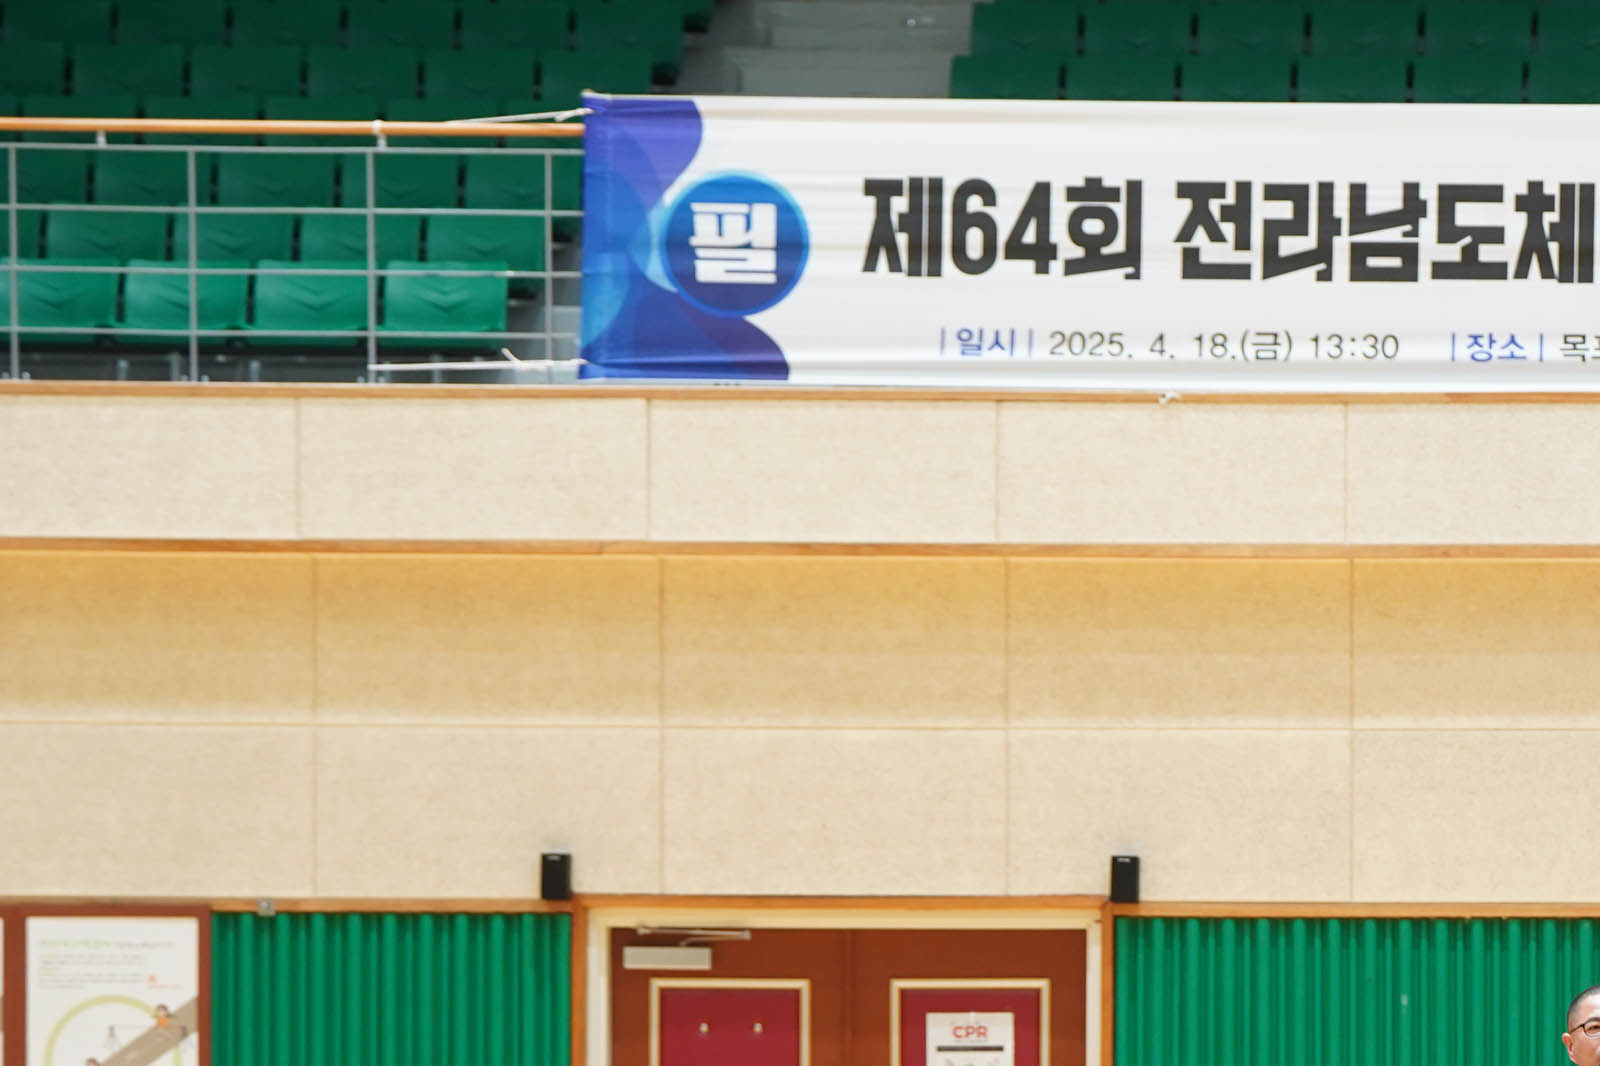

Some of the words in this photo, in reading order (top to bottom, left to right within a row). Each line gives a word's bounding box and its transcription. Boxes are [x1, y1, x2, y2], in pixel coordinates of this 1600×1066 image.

[690, 202, 779, 285] 필
[862, 175, 1142, 281] 제64회
[1310, 334, 1400, 360] 13:30
[952, 1025, 988, 1039] CPR
